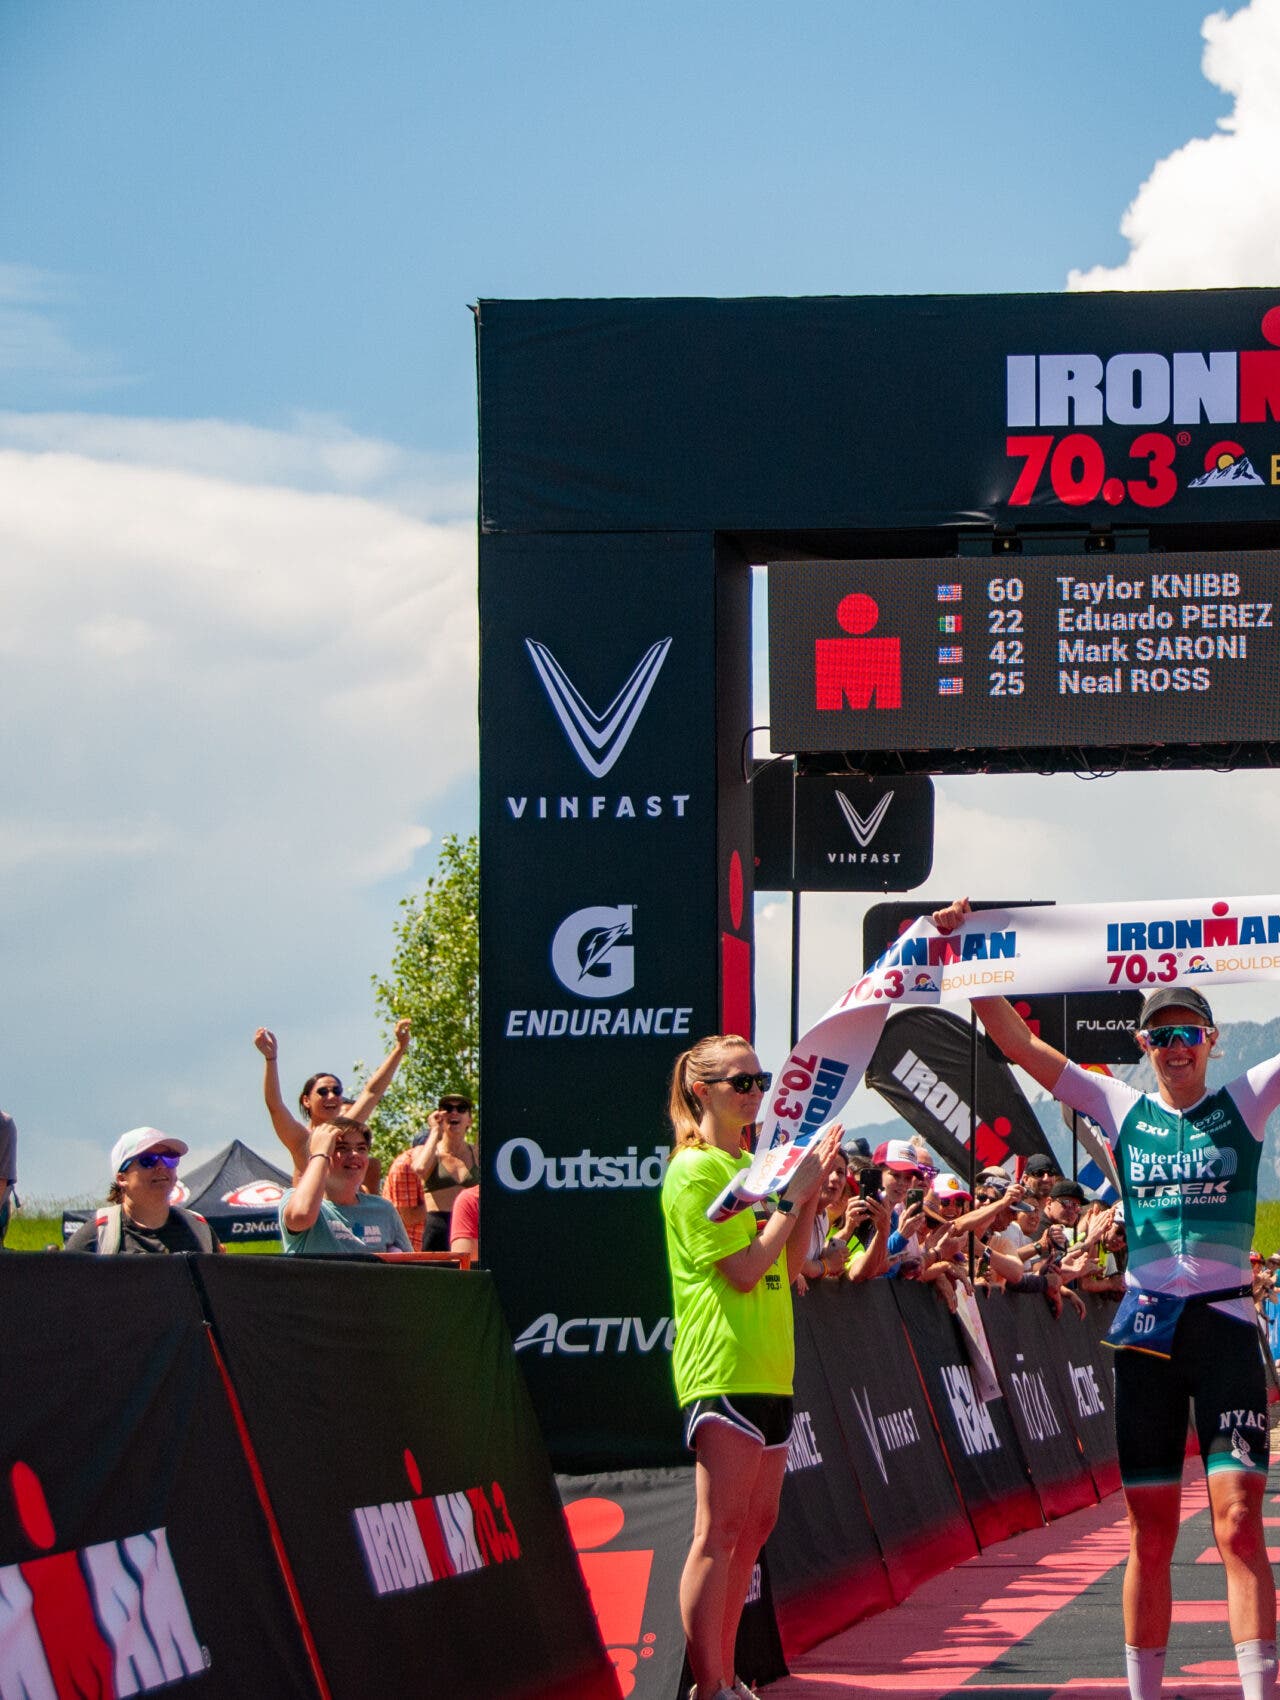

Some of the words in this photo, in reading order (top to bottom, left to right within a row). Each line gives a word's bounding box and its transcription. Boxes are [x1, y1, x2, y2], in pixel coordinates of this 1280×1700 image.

[1006, 432, 1178, 508] 70.3
[988, 578, 1024, 602] 60
[1057, 576, 1144, 605] Taylor
[1151, 573, 1240, 600] KNIBB
[988, 609, 1024, 634] 22
[1057, 606, 1173, 632] Eduardo
[1182, 603, 1273, 630] PEREZ
[988, 641, 1025, 664] 42
[1058, 637, 1128, 663] Mark
[1136, 635, 1248, 661] SARONI
[988, 671, 1025, 696] 25
[1058, 669, 1122, 694] Neal
[1130, 668, 1211, 692] ROSS
[508, 794, 690, 818] VINFAST
[828, 853, 901, 864] VINFAST
[941, 970, 1015, 992] BOULDER
[1107, 953, 1178, 985] 70.3
[506, 1007, 693, 1037] ENDURANCE
[1076, 1019, 1136, 1031] FULGAZ
[773, 1055, 819, 1121] 70.3
[1136, 1120, 1170, 1137] 2XU
[496, 1137, 671, 1191] Outsid
[1127, 1144, 1205, 1164] Waterfall
[1130, 1159, 1216, 1182] BANK
[1131, 1180, 1231, 1198] TREK
[1137, 1197, 1183, 1209] FACTORY
[1184, 1195, 1228, 1205] RACING
[1133, 1311, 1156, 1334] 60
[941, 1364, 1001, 1456] HOKA
[1219, 1409, 1266, 1431] NYAC
[877, 1407, 921, 1451] VINFAST
[354, 1490, 484, 1594] IRONMAN
[465, 1480, 521, 1564] 70.3
